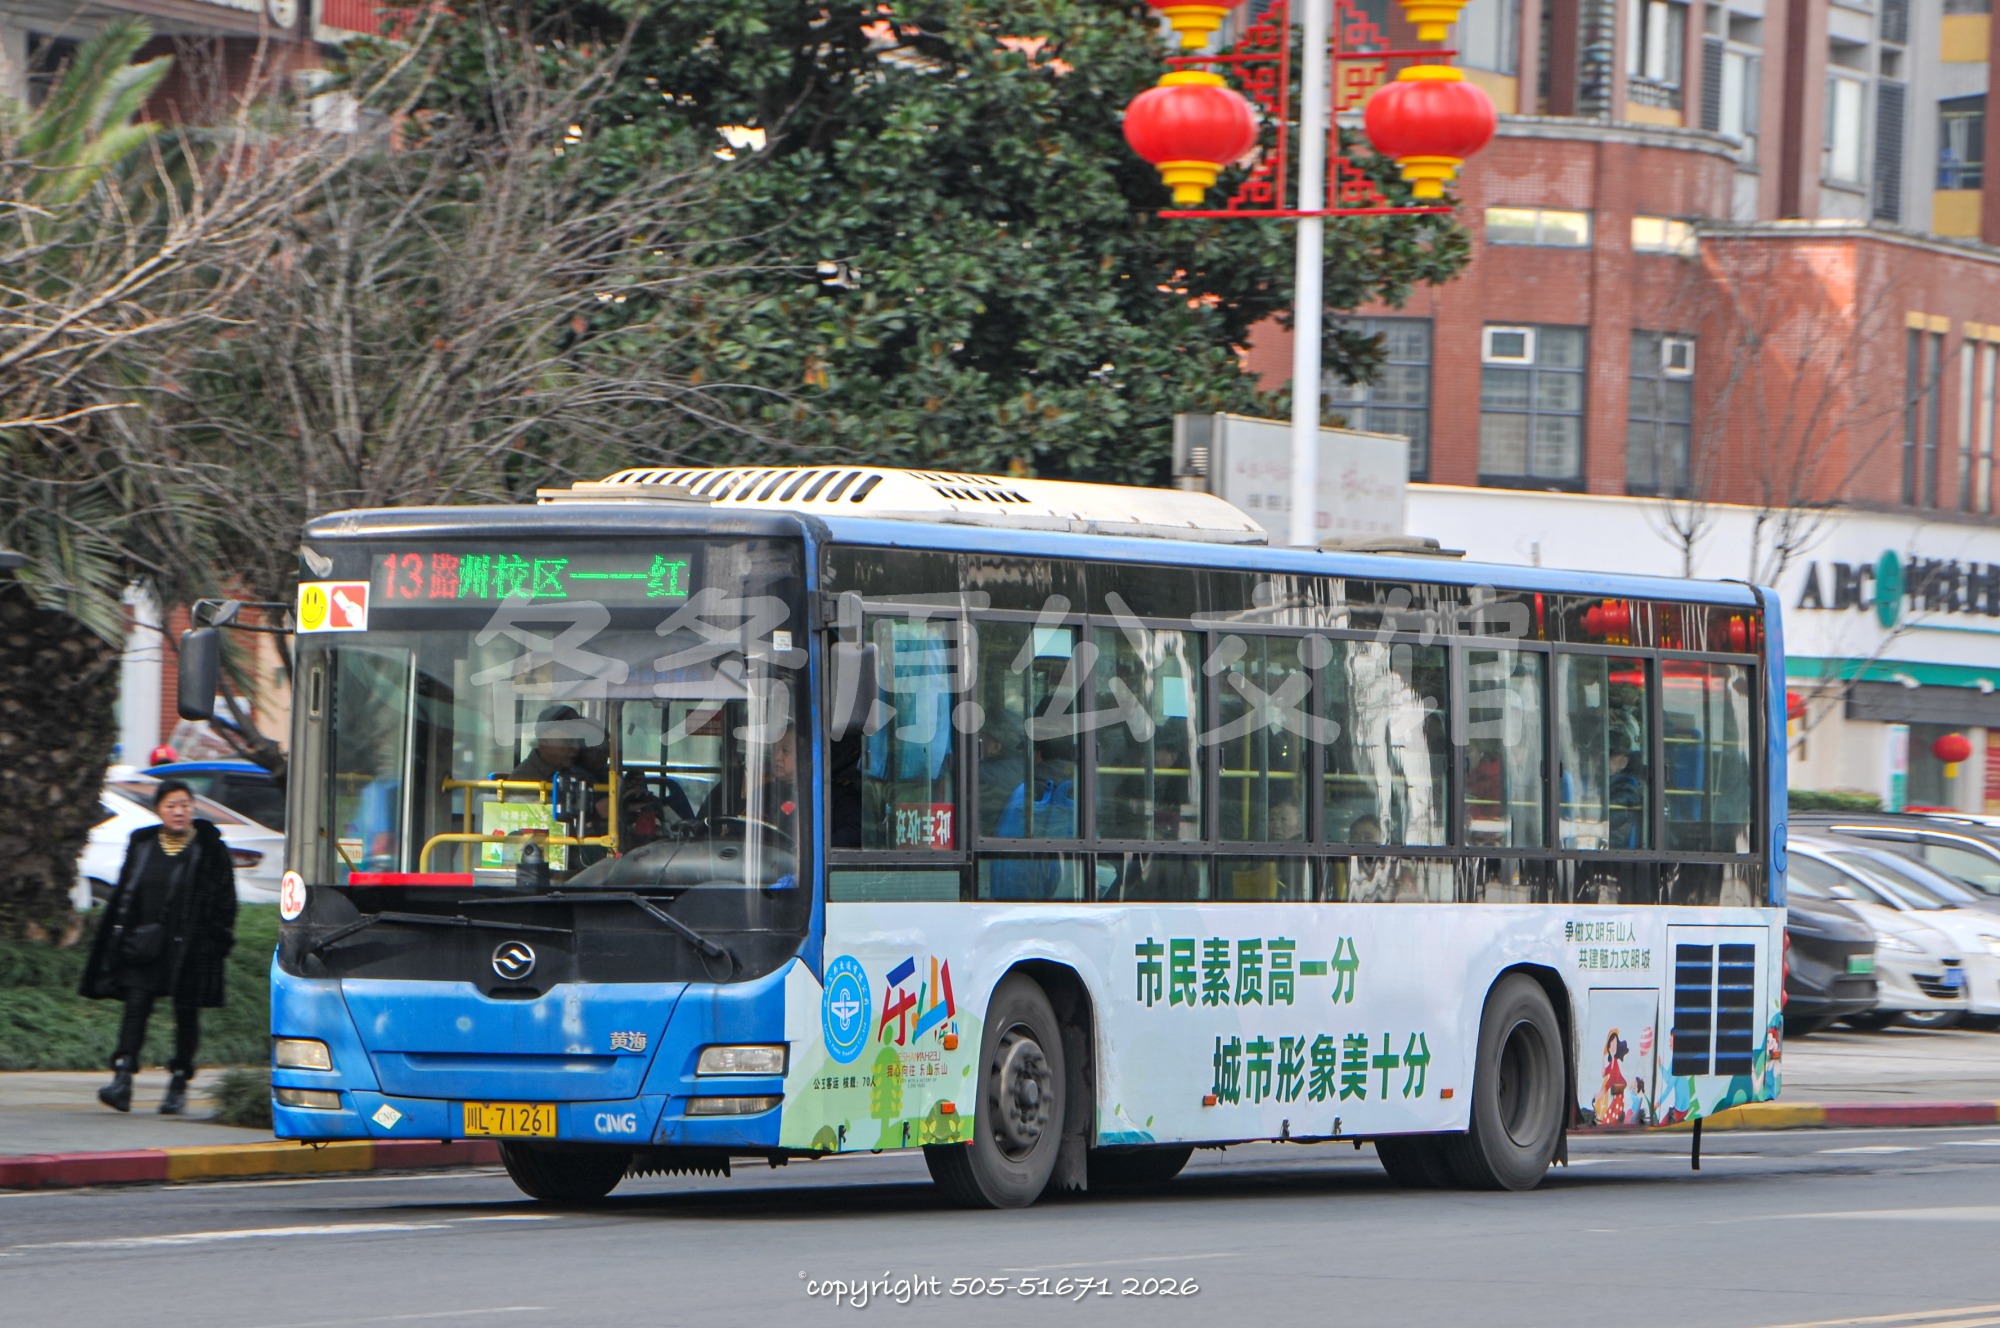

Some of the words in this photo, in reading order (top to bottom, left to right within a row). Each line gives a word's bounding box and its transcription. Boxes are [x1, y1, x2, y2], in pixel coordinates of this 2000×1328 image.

[1564, 921, 1636, 942] 争做文明乐山人
[1578, 947, 1651, 969] 共建魅力文明城
[1135, 936, 1360, 1008] 市民素质高一分
[610, 1030, 648, 1052] 黄海
[1211, 1031, 1431, 1105] 城市形象美十分
[377, 1110, 397, 1122] CNG
[594, 1112, 637, 1134] CNG
